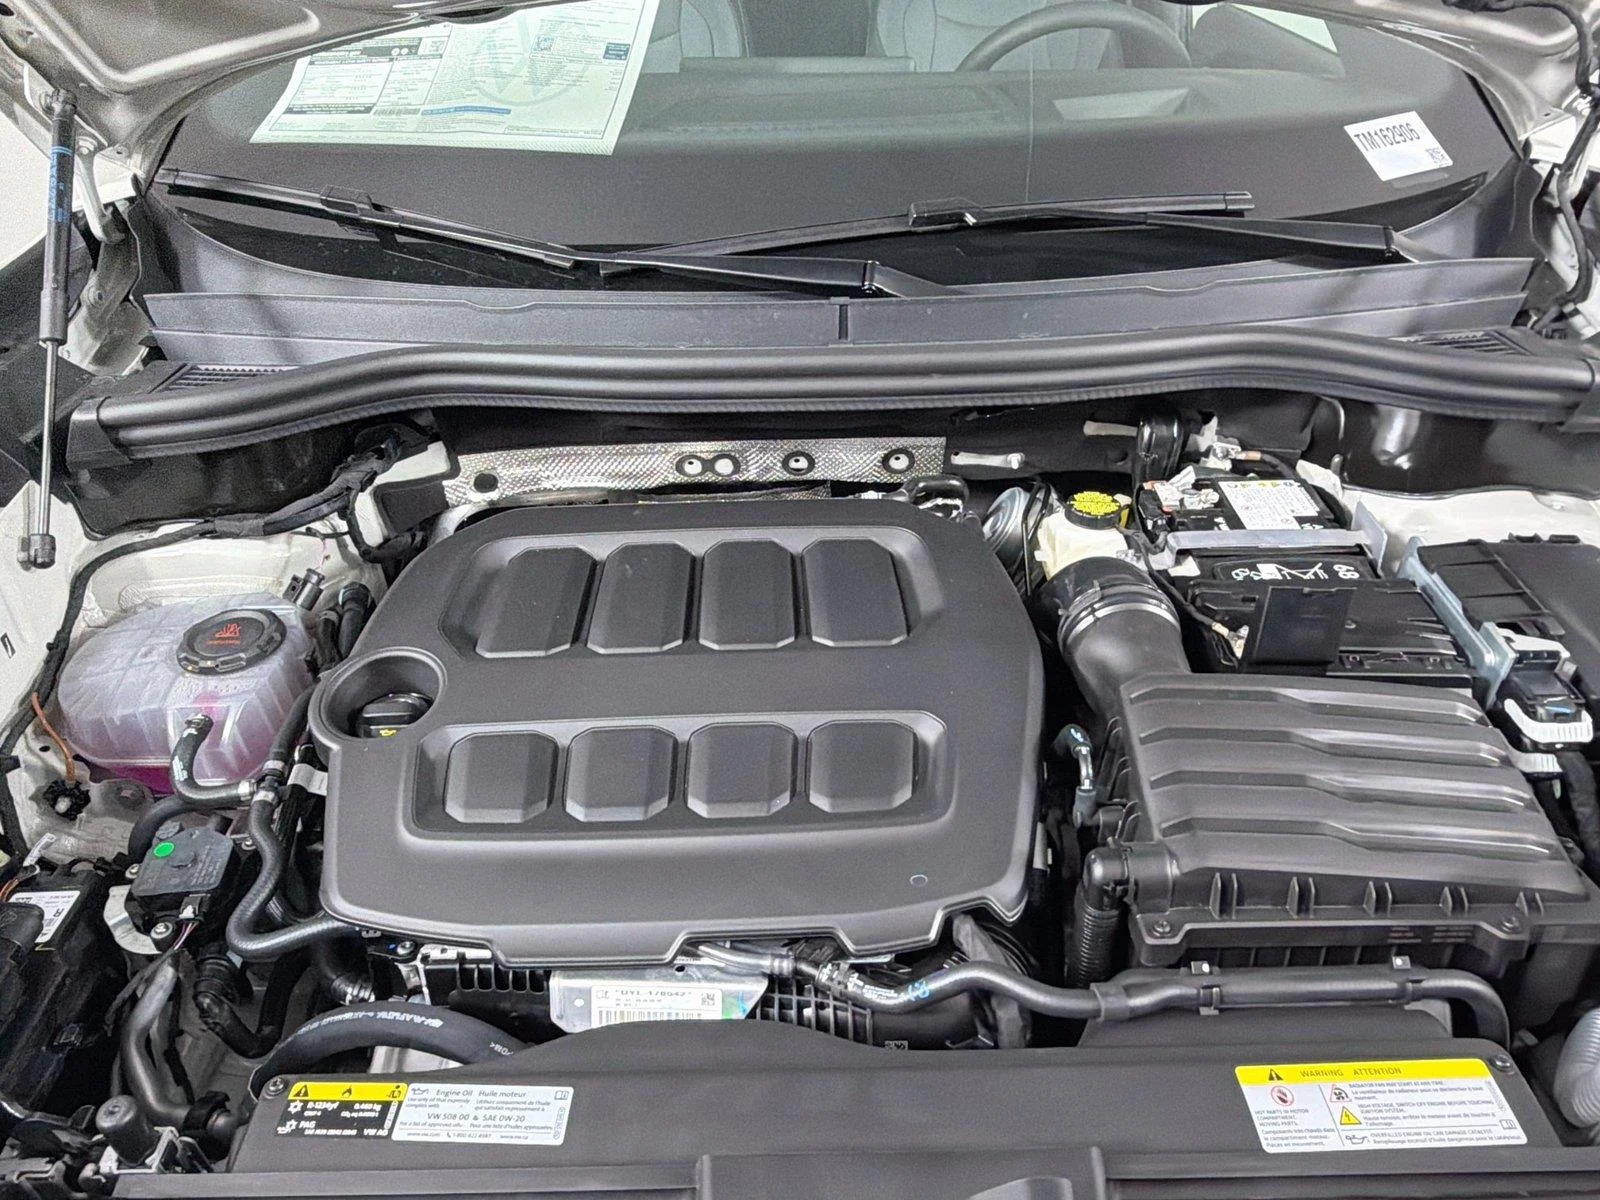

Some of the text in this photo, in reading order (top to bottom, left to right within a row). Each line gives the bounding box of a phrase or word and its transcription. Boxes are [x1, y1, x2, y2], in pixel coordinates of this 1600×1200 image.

[1353, 122, 1420, 152] TM162906
[1300, 1067, 1402, 1078] WARNING ATTENTION
[436, 1089, 461, 1097] Engine
